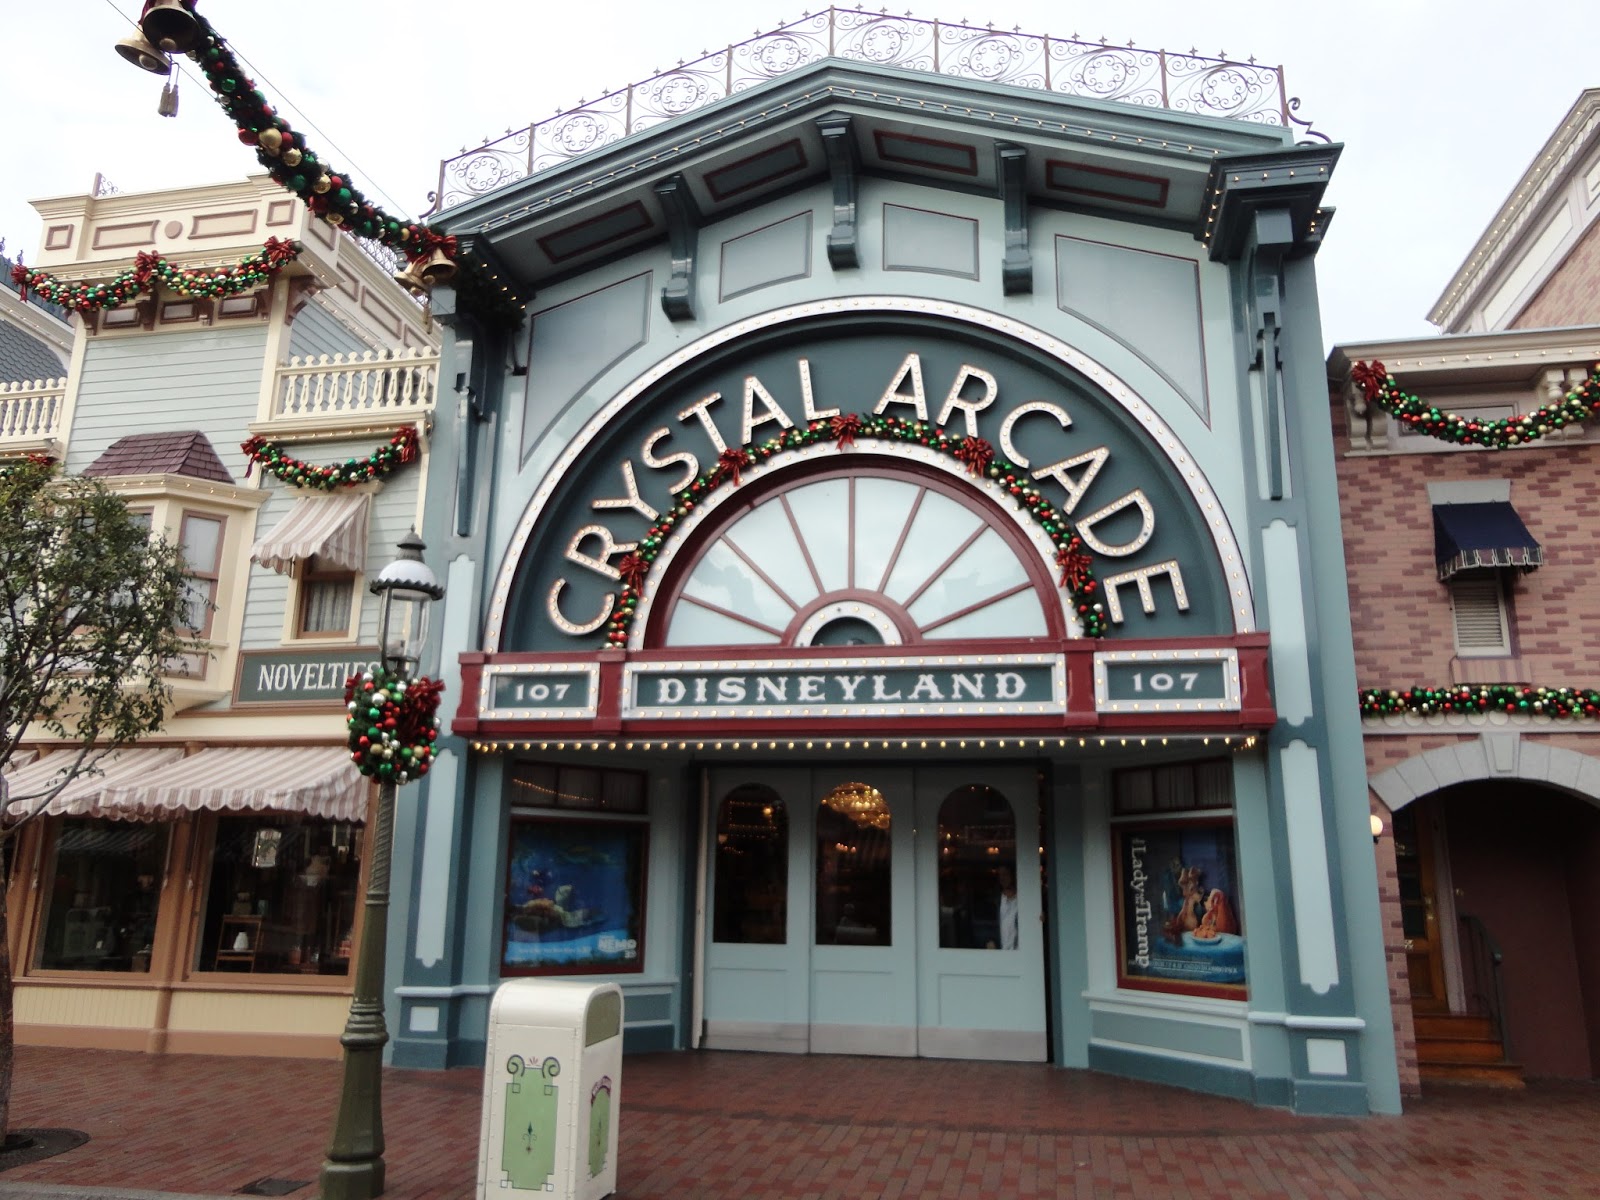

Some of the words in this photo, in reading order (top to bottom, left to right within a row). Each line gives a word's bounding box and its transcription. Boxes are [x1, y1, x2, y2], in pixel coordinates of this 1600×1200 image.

[547, 358, 840, 635] CRYSTAL
[873, 352, 1190, 623] ARCADE
[514, 682, 572, 701] 107
[657, 672, 1027, 704] DISNEYLAND
[1132, 672, 1199, 692] 107
[1131, 846, 1148, 892] Lady
[1135, 900, 1152, 968] Tramp
